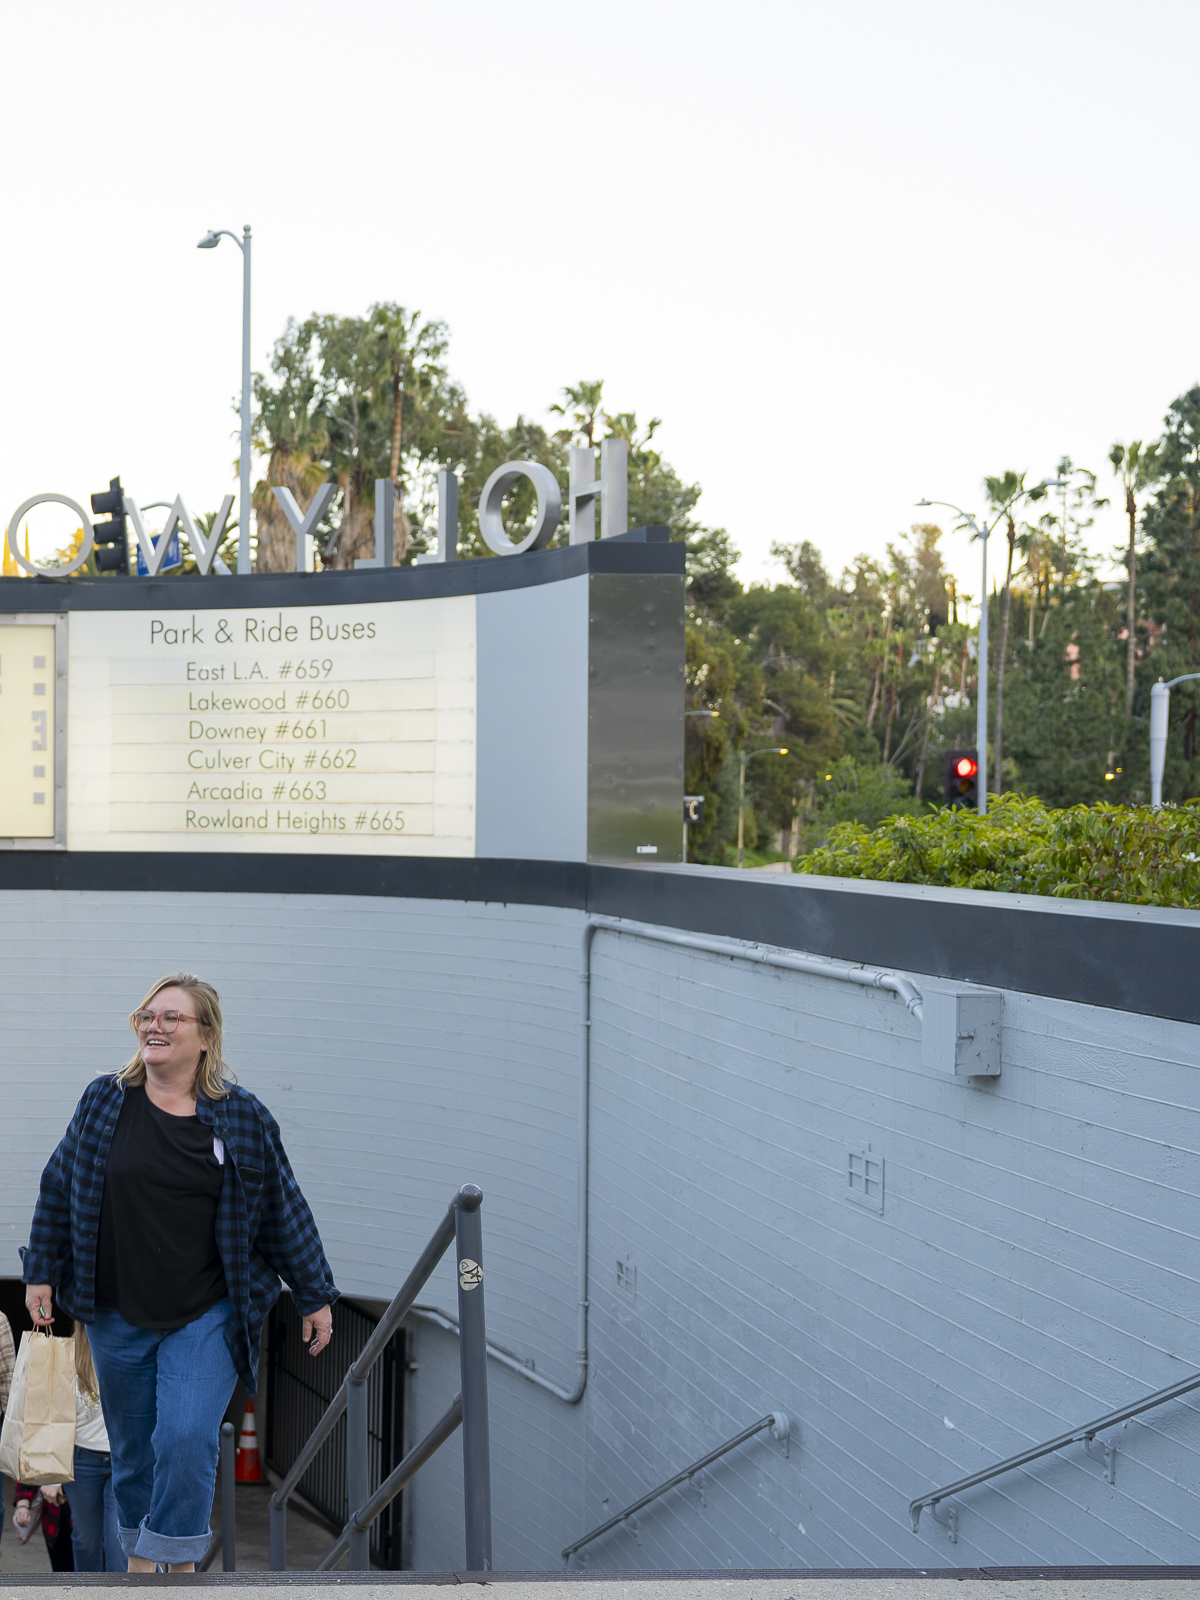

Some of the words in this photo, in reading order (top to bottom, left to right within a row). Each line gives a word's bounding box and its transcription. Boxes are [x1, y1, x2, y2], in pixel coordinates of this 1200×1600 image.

[150, 615, 204, 644] Park
[215, 619, 233, 643] &
[245, 613, 298, 642] Ride
[310, 616, 376, 640] Buses
[187, 662, 225, 680] East
[234, 661, 268, 680] L.A.
[279, 659, 333, 679] #659
[189, 691, 286, 711] Lakewood
[295, 689, 349, 709] #660
[32, 710, 47, 750] 3
[189, 721, 266, 743] Downey
[275, 720, 327, 738] #661
[188, 750, 251, 769] Culver
[259, 749, 295, 772] City
[304, 749, 357, 768] #662
[187, 781, 262, 799] Arcadia
[272, 781, 326, 800] #663
[186, 810, 268, 829] Rowland
[277, 810, 345, 833] Heights
[354, 811, 404, 831] #665
